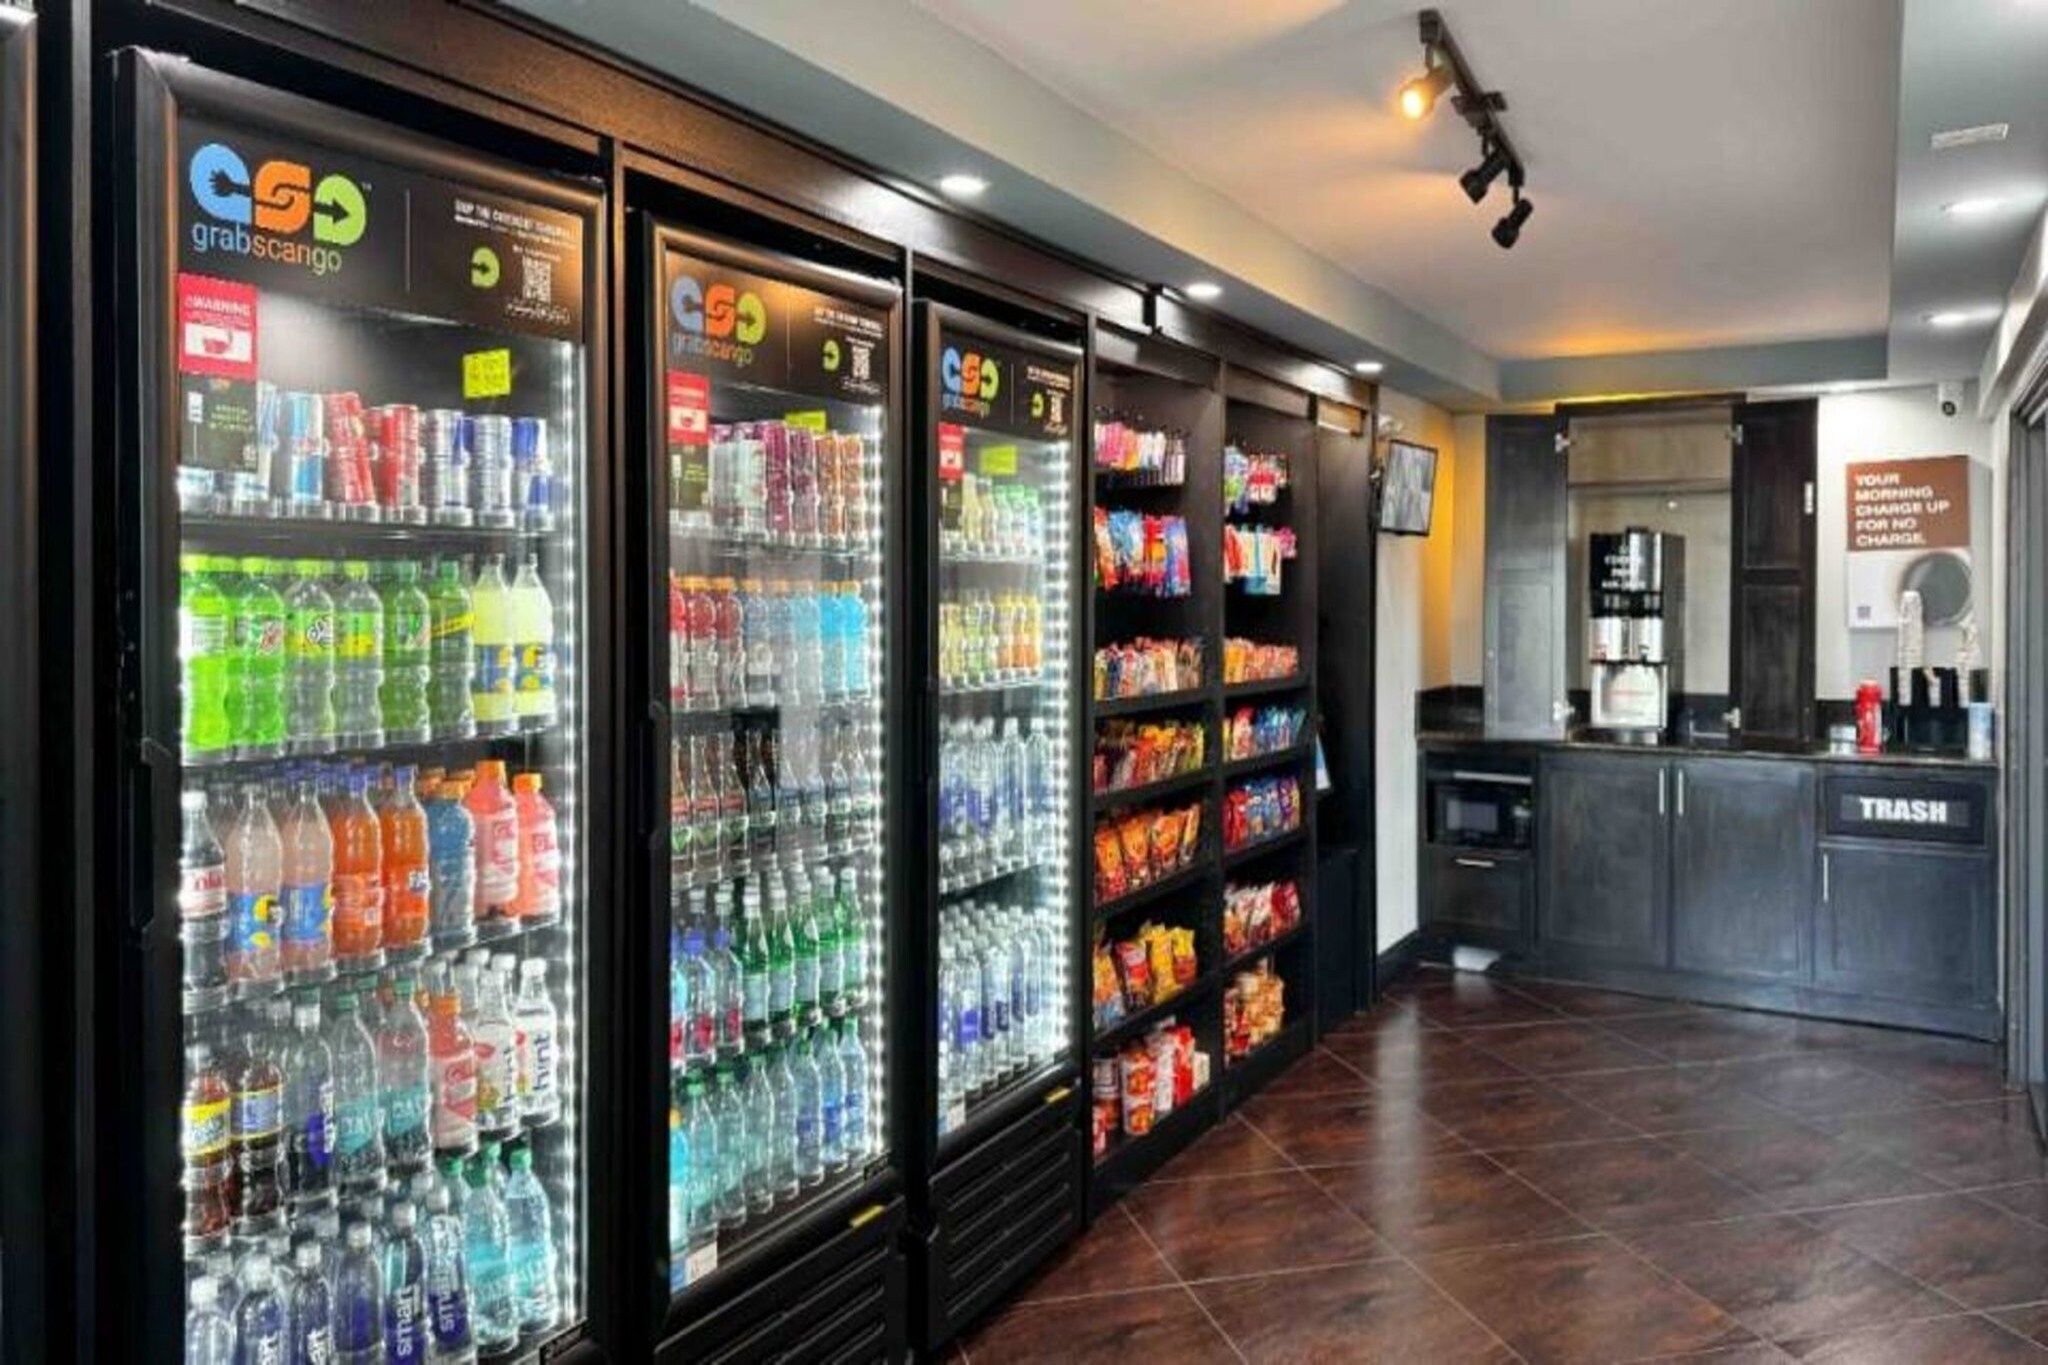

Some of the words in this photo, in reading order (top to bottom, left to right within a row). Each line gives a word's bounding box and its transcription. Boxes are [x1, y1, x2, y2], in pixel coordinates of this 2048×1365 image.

[191, 221, 343, 276] grabscango
[1854, 473, 1900, 486] YOUR
[1855, 485, 1933, 502] MORNING
[1855, 502, 1922, 517] CHARGE
[1925, 499, 1950, 514] UP
[1856, 518, 1888, 531] FOR
[1892, 517, 1917, 530] NO
[1860, 797, 1947, 823] TRASH
[533, 1033, 550, 1091] hint
